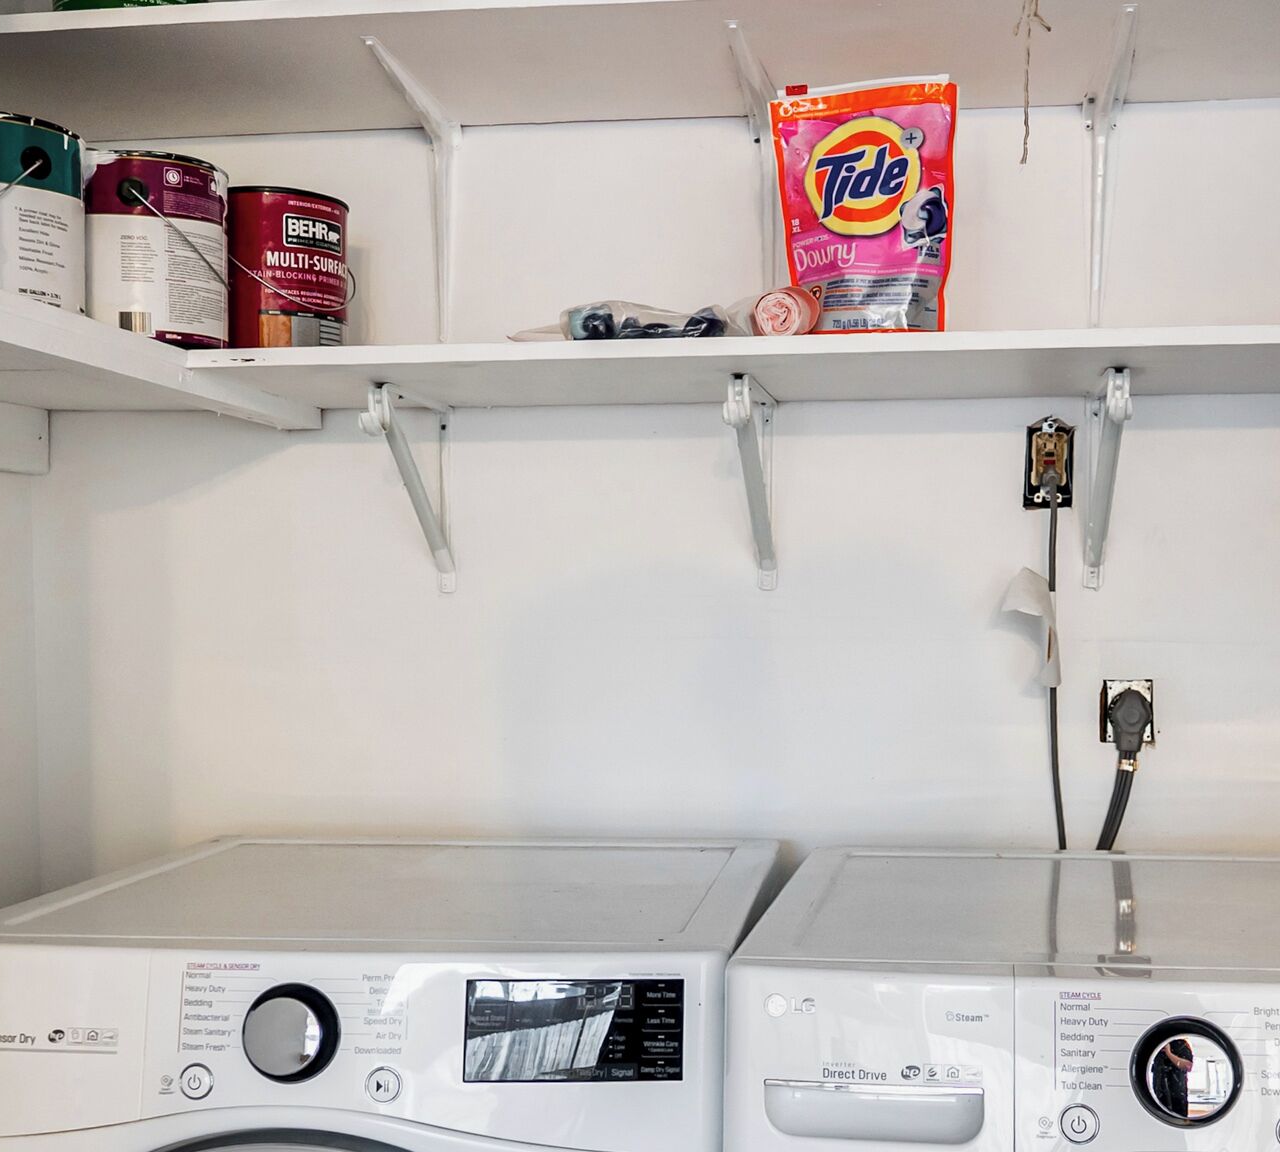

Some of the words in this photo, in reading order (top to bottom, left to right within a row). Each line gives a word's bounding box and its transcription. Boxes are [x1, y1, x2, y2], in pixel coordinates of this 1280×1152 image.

[815, 144, 908, 219] Tide
[288, 218, 328, 241] BEHR
[793, 242, 857, 272] Downy
[248, 270, 317, 282] TAIN-BLOCKING
[29, 288, 46, 296] GALLON
[184, 999, 212, 1008] Bedding
[791, 998, 816, 1014] LG
[1253, 1007, 1279, 1017] Bright
[1060, 1017, 1086, 1026] Heavy
[1089, 1018, 1108, 1026] Duty
[20, 1034, 36, 1045] Dry
[1060, 1033, 1094, 1042] Bedding
[1061, 1048, 1096, 1058] Sanitary
[612, 1069, 633, 1077] Signal
[823, 1068, 855, 1080] Direct
[859, 1070, 887, 1080] Drive
[1061, 1081, 1077, 1090] Tub
[1079, 1081, 1102, 1090] Clean
